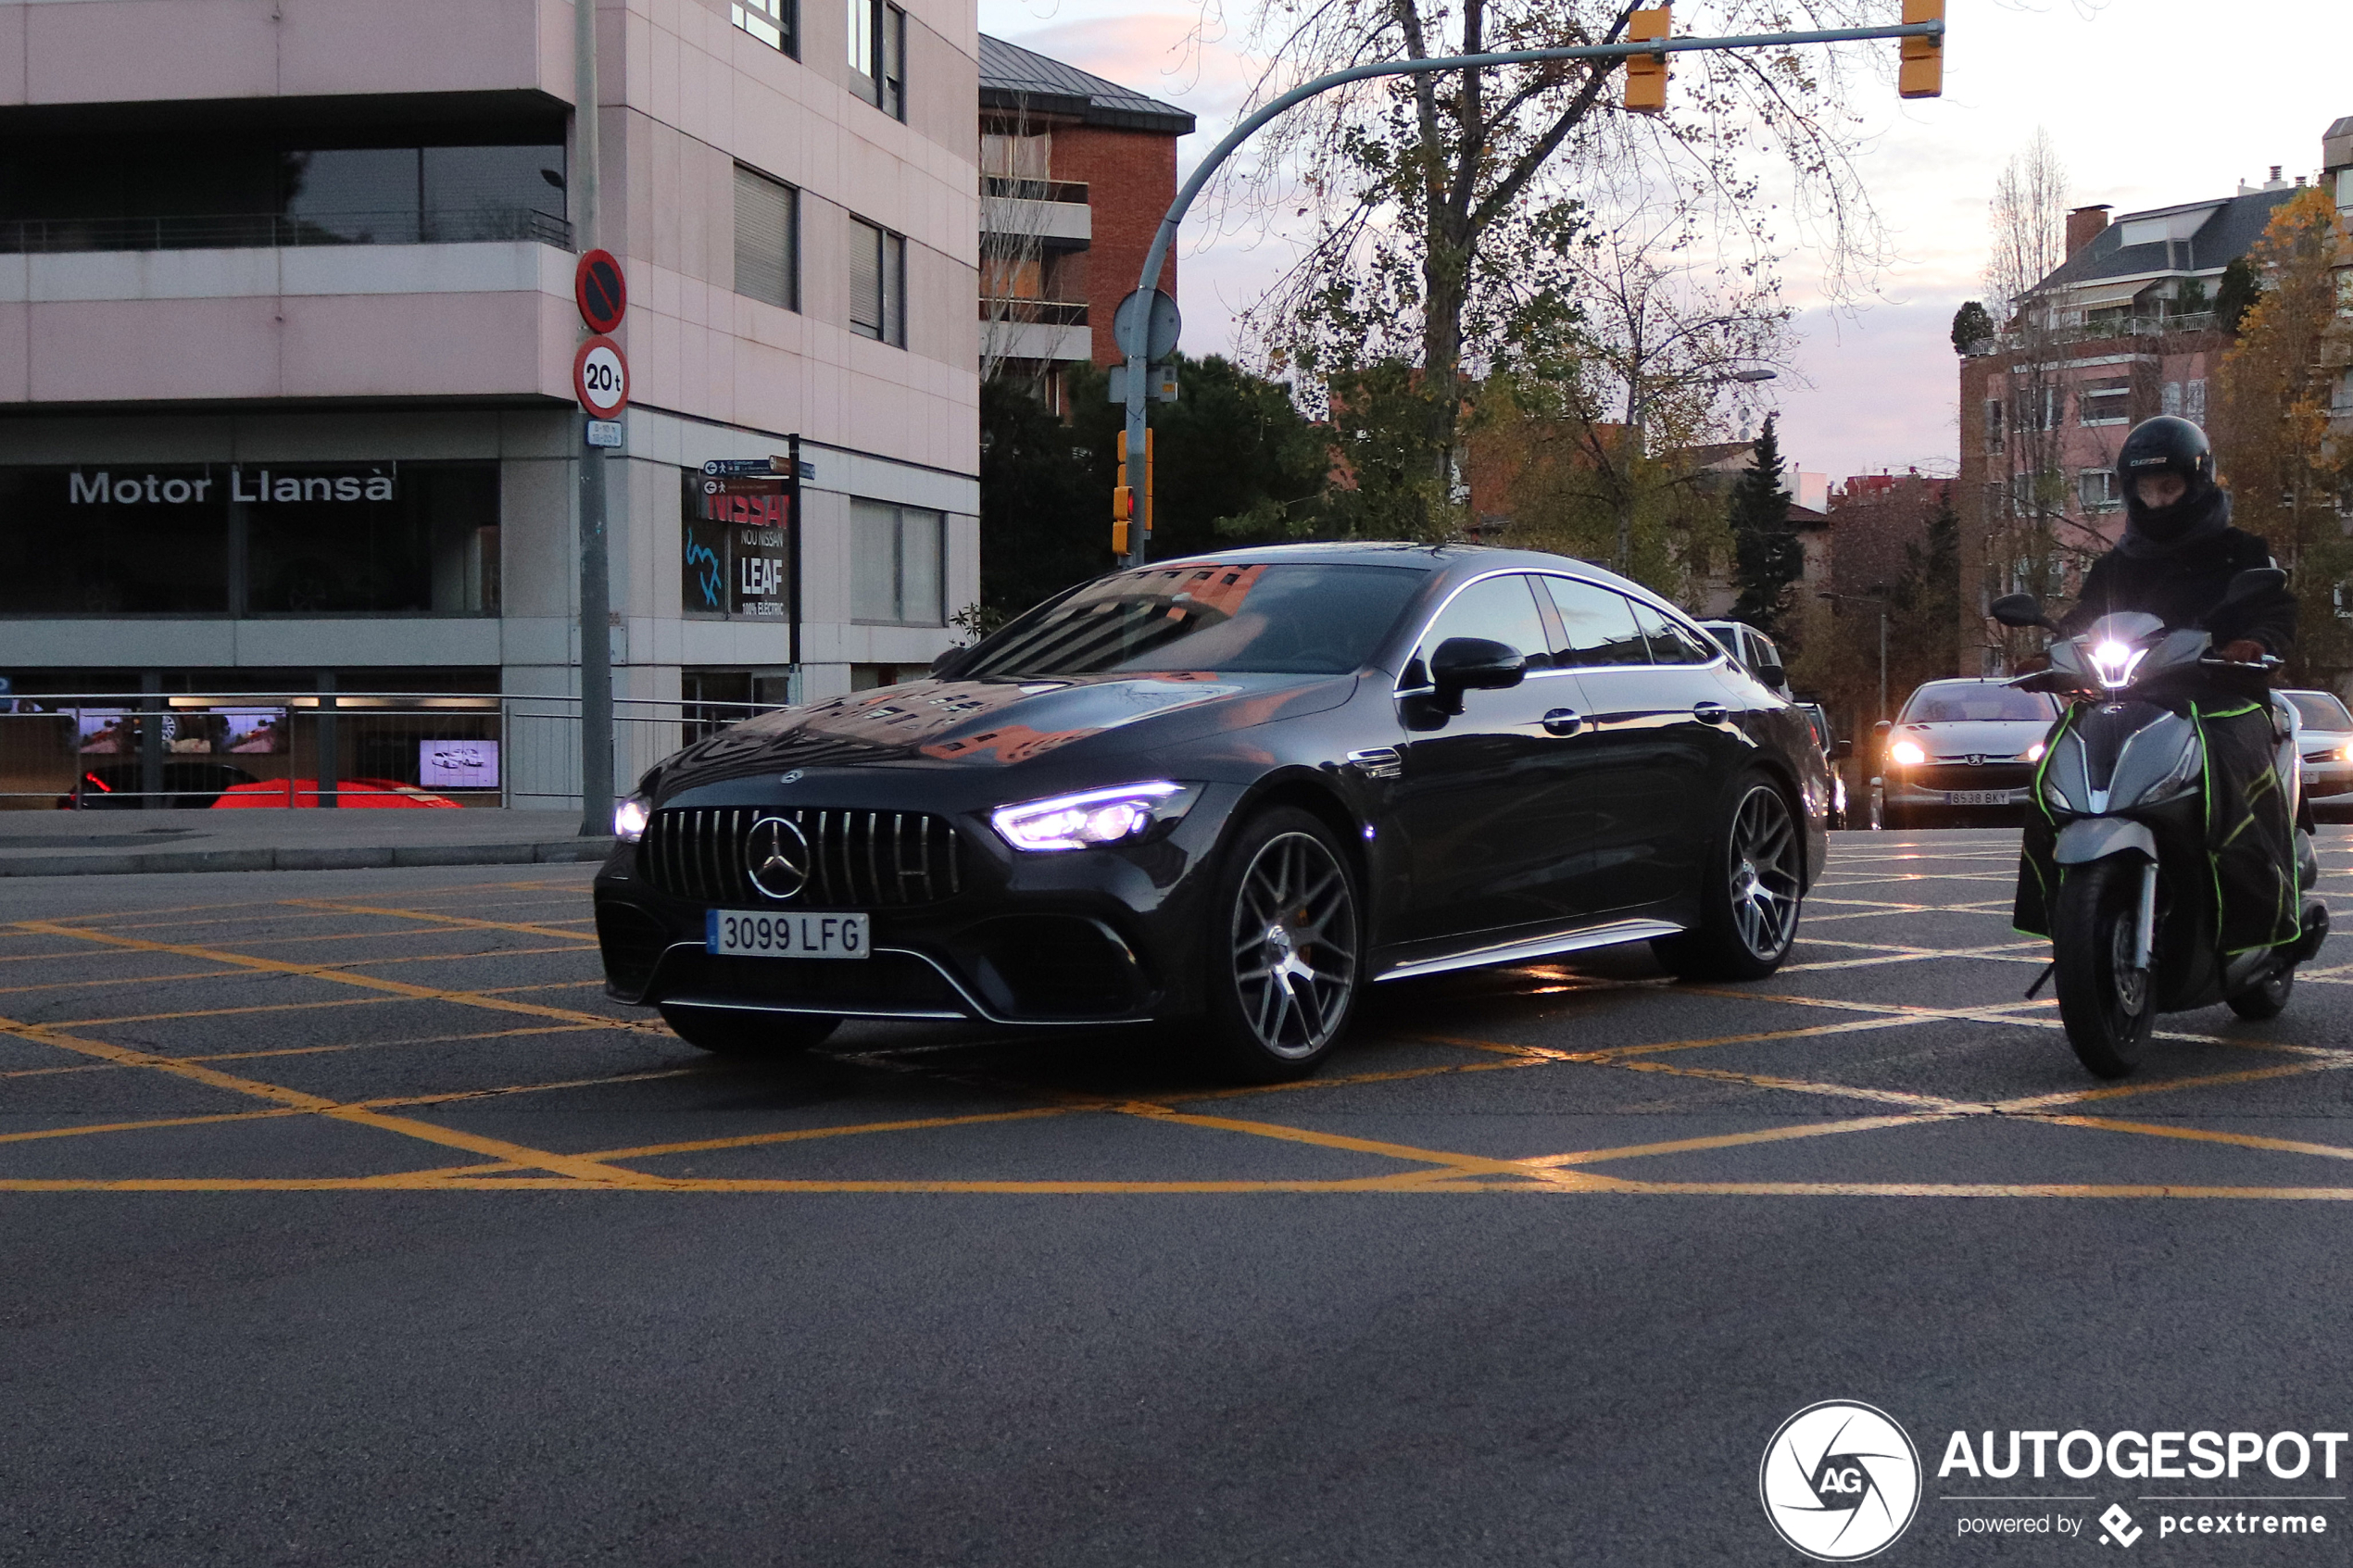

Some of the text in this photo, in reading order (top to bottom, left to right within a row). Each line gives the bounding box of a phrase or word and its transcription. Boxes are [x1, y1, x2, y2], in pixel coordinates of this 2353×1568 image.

[69, 468, 394, 504] Motor Llansà
[741, 529, 784, 547] NOU NISSAN
[741, 557, 783, 595] LEAF
[1985, 793, 2007, 804] BKY
[724, 916, 859, 952] 3099 LFG
